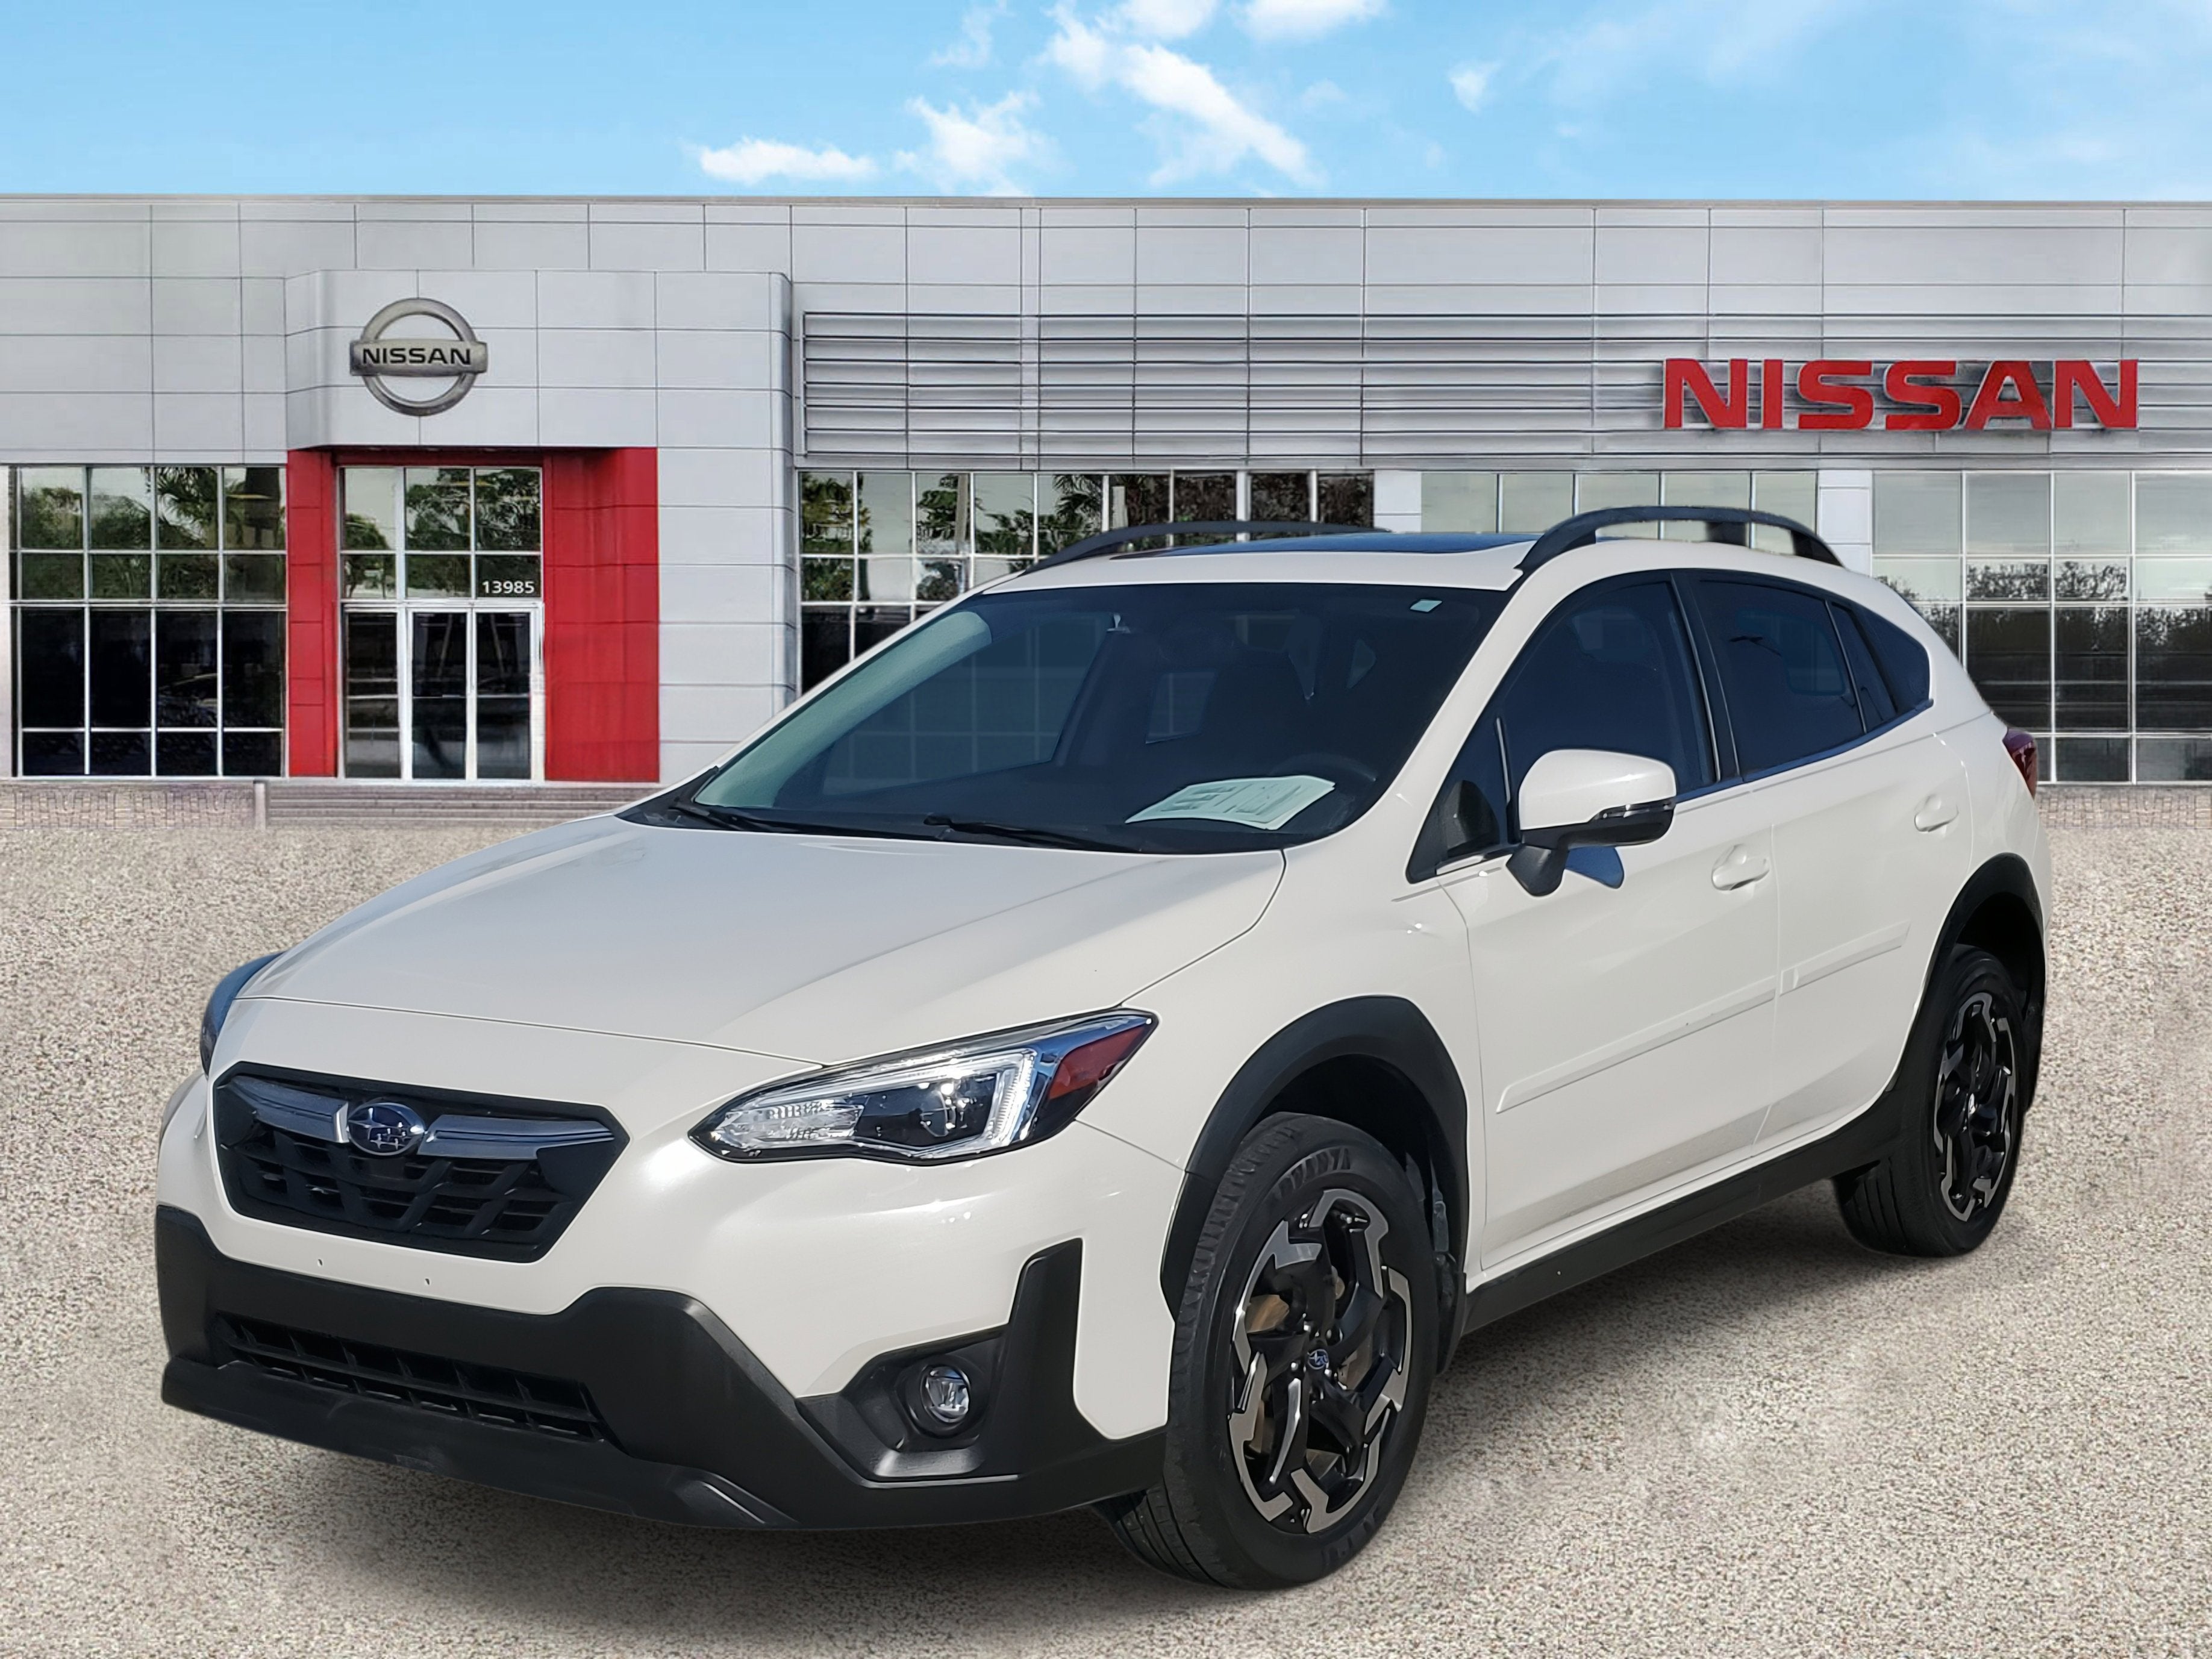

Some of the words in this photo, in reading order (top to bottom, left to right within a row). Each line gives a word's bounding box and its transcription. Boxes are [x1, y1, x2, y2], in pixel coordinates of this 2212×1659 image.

[363, 348, 471, 365] NISSAN
[1663, 358, 2139, 430] NISSAN
[483, 580, 535, 593] 13985
